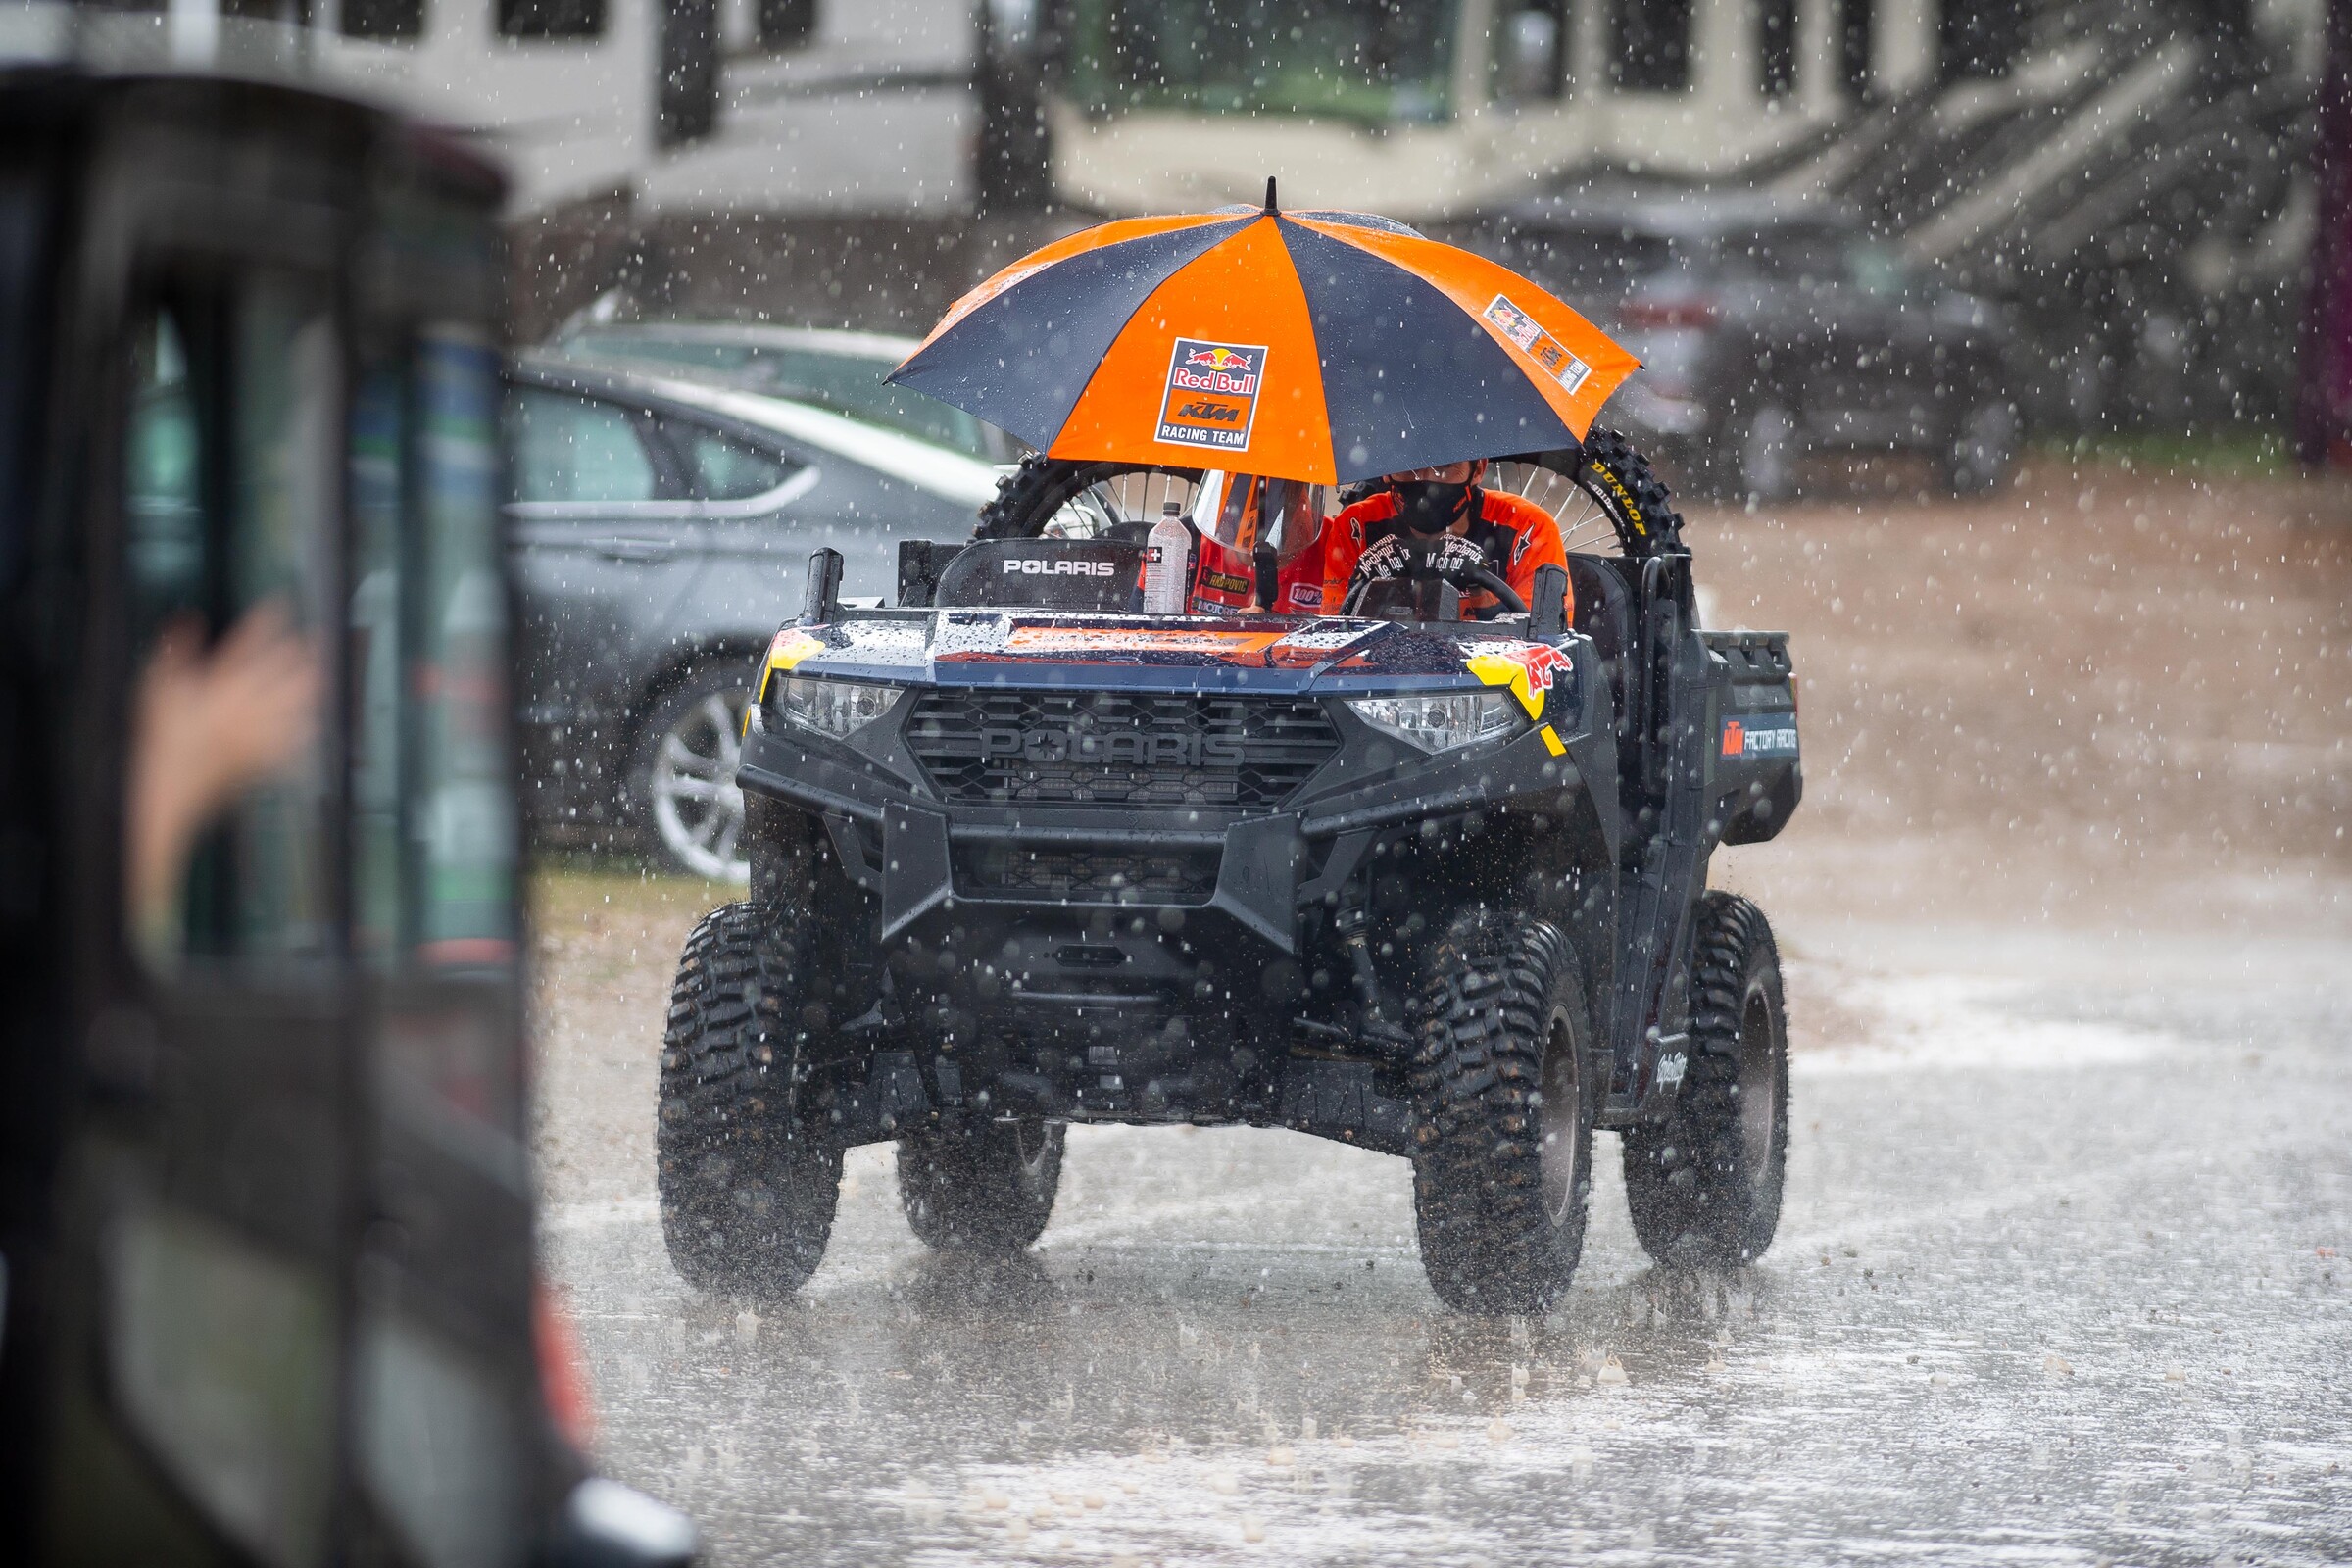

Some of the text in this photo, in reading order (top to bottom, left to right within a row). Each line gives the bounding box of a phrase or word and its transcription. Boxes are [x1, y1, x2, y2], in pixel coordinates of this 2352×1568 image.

[1173, 367, 1257, 394] Red Bull
[1178, 402, 1240, 422] KTM
[1162, 425, 1245, 445] RACING TEAM
[1590, 463, 1646, 535] DUNLOP
[1359, 543, 1395, 578] Mechanix
[1374, 547, 1411, 578] Mehaix
[1426, 552, 1464, 569] Mchnix
[1446, 540, 1483, 564] Mechanix
[1003, 560, 1115, 576] POLARIS
[1198, 599, 1239, 615] MOTORE
[1294, 588, 1322, 604] 100%
[981, 728, 1246, 766] POLARIS
[1744, 729, 1776, 751] FACTORY
